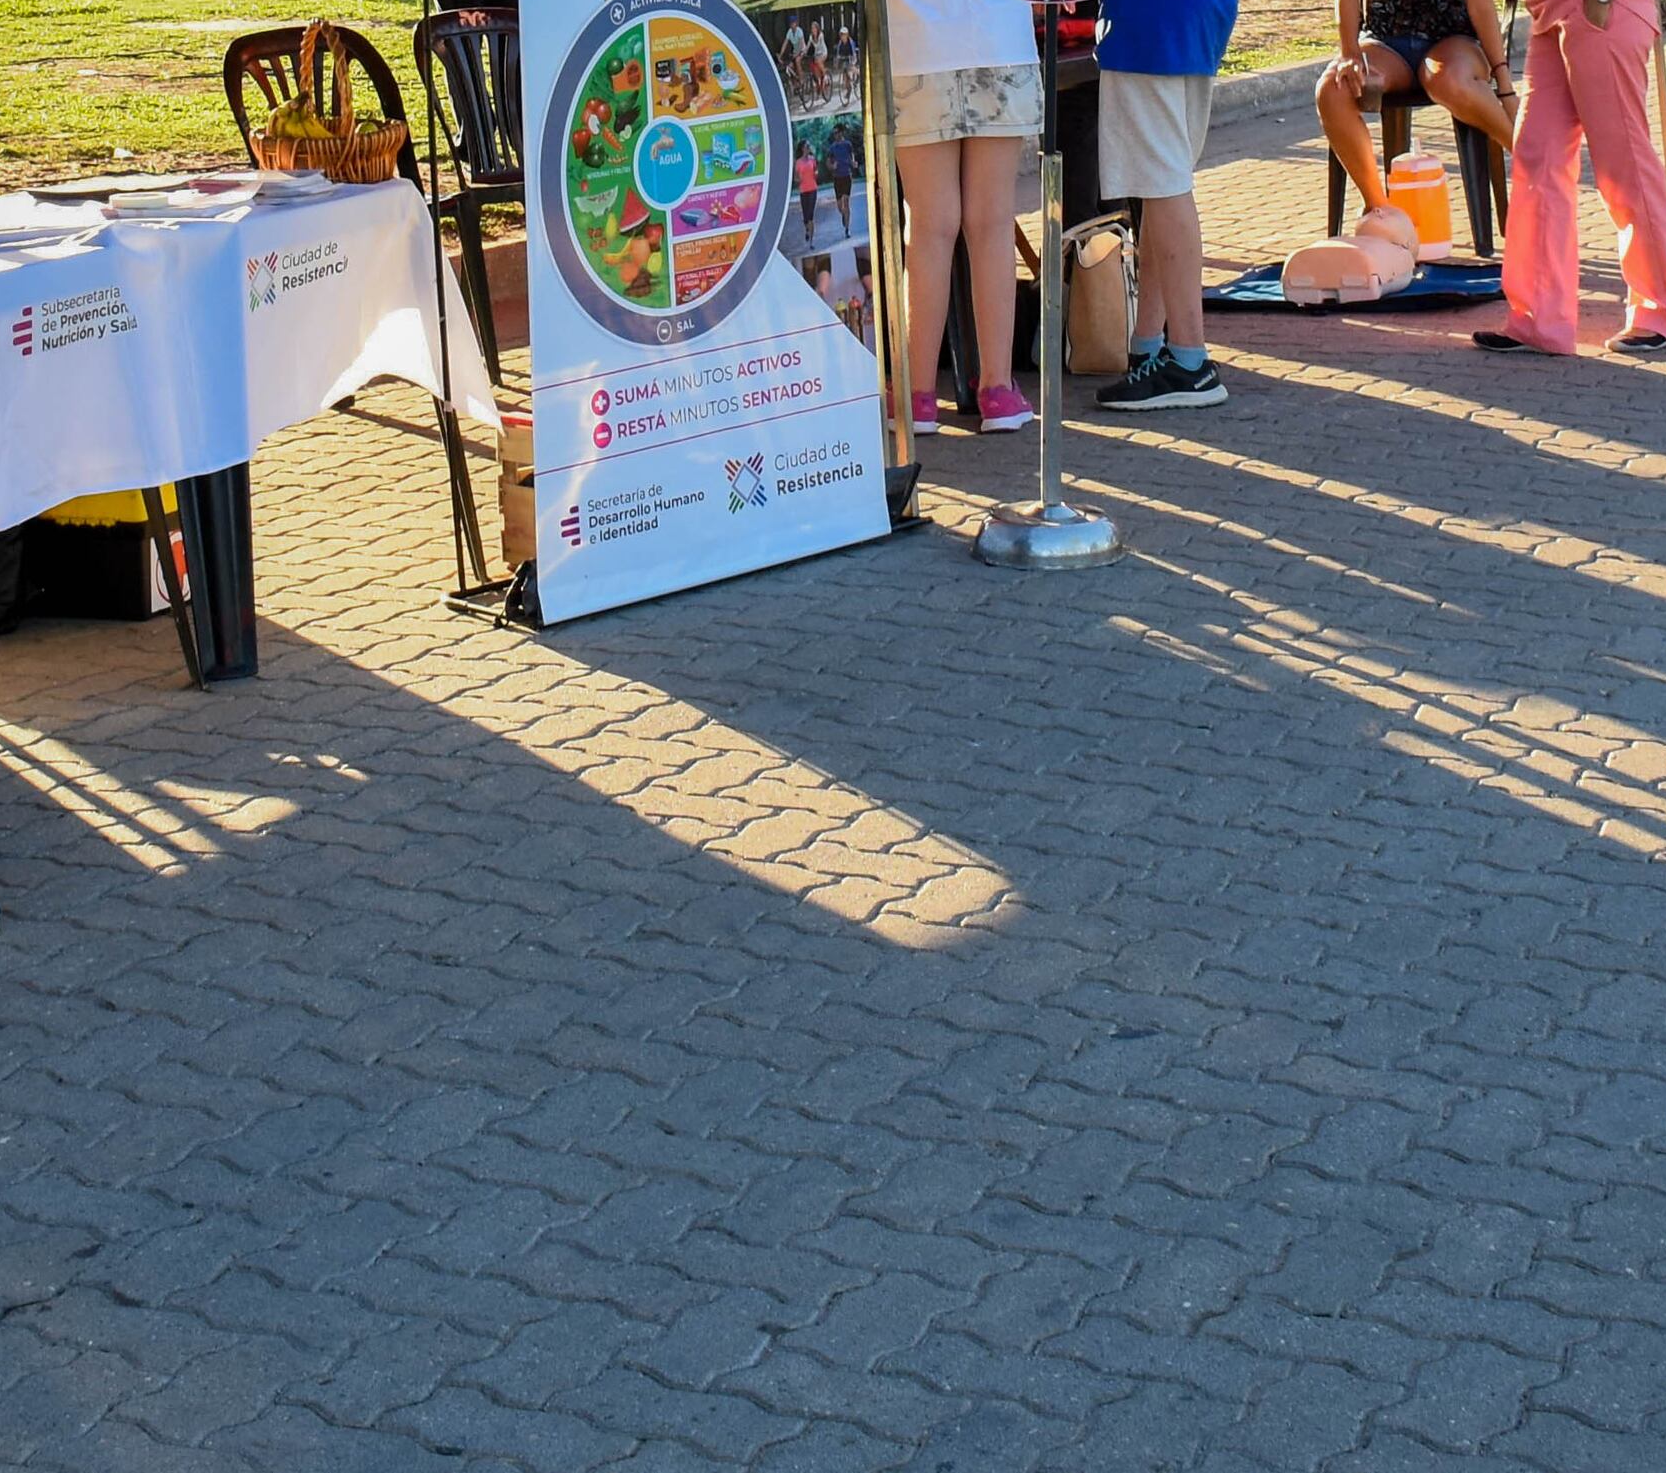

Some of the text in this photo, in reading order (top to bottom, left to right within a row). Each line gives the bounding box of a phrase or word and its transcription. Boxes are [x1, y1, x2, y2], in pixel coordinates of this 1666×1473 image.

[659, 152, 683, 166] AGUA
[282, 241, 338, 270] Ciudad de
[41, 286, 121, 317] Subsecretaría
[42, 300, 129, 334] de Prevención
[42, 327, 94, 352] Nutrición
[98, 324, 107, 339] y
[677, 319, 695, 334] SAL
[614, 350, 802, 406] SUMÁ MINUTOS ACTIVOS
[617, 378, 823, 439] RESTÁ MINUTOS SENTADOS
[774, 440, 851, 472] Ciudad de
[777, 461, 864, 496] Resistencia
[588, 484, 663, 513] Secretaría de
[589, 490, 706, 529] Desarrollo Humano
[589, 516, 659, 545] e Identidad
